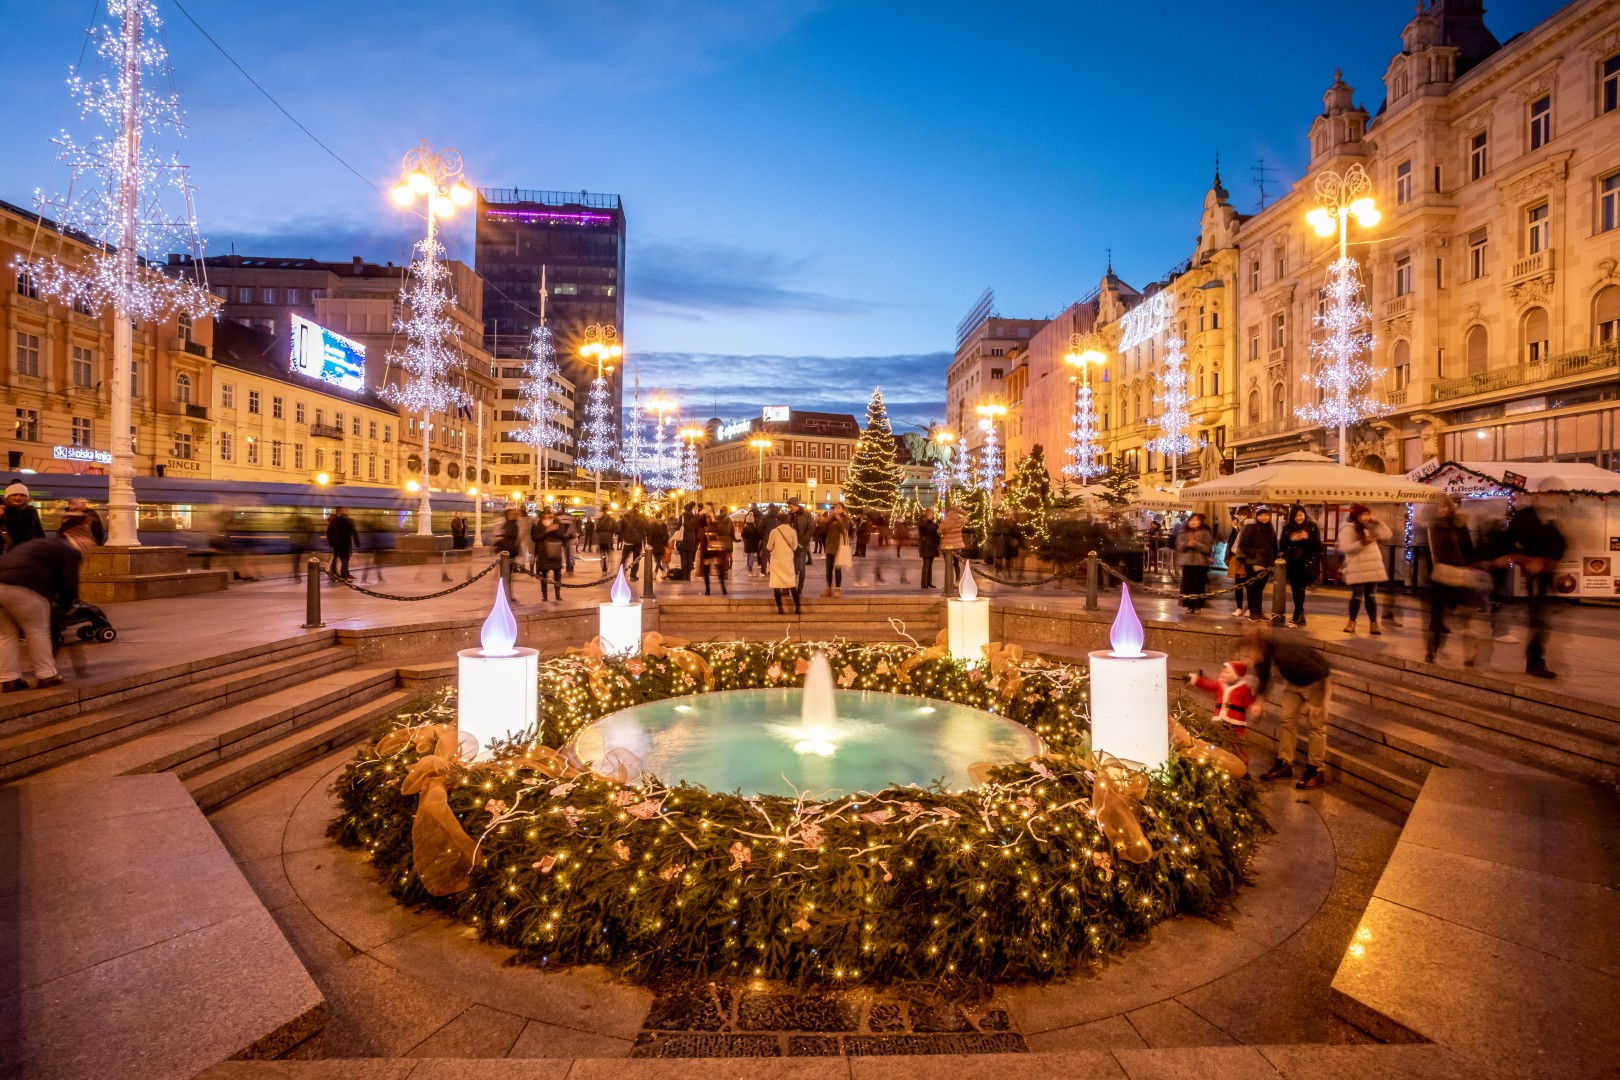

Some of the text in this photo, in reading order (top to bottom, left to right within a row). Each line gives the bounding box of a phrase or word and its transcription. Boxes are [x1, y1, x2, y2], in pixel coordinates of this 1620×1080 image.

[1118, 292, 1165, 353] 2019
[68, 447, 94, 460] školska
[167, 459, 200, 470] SINGER
[1391, 489, 1436, 499] Jamnica
